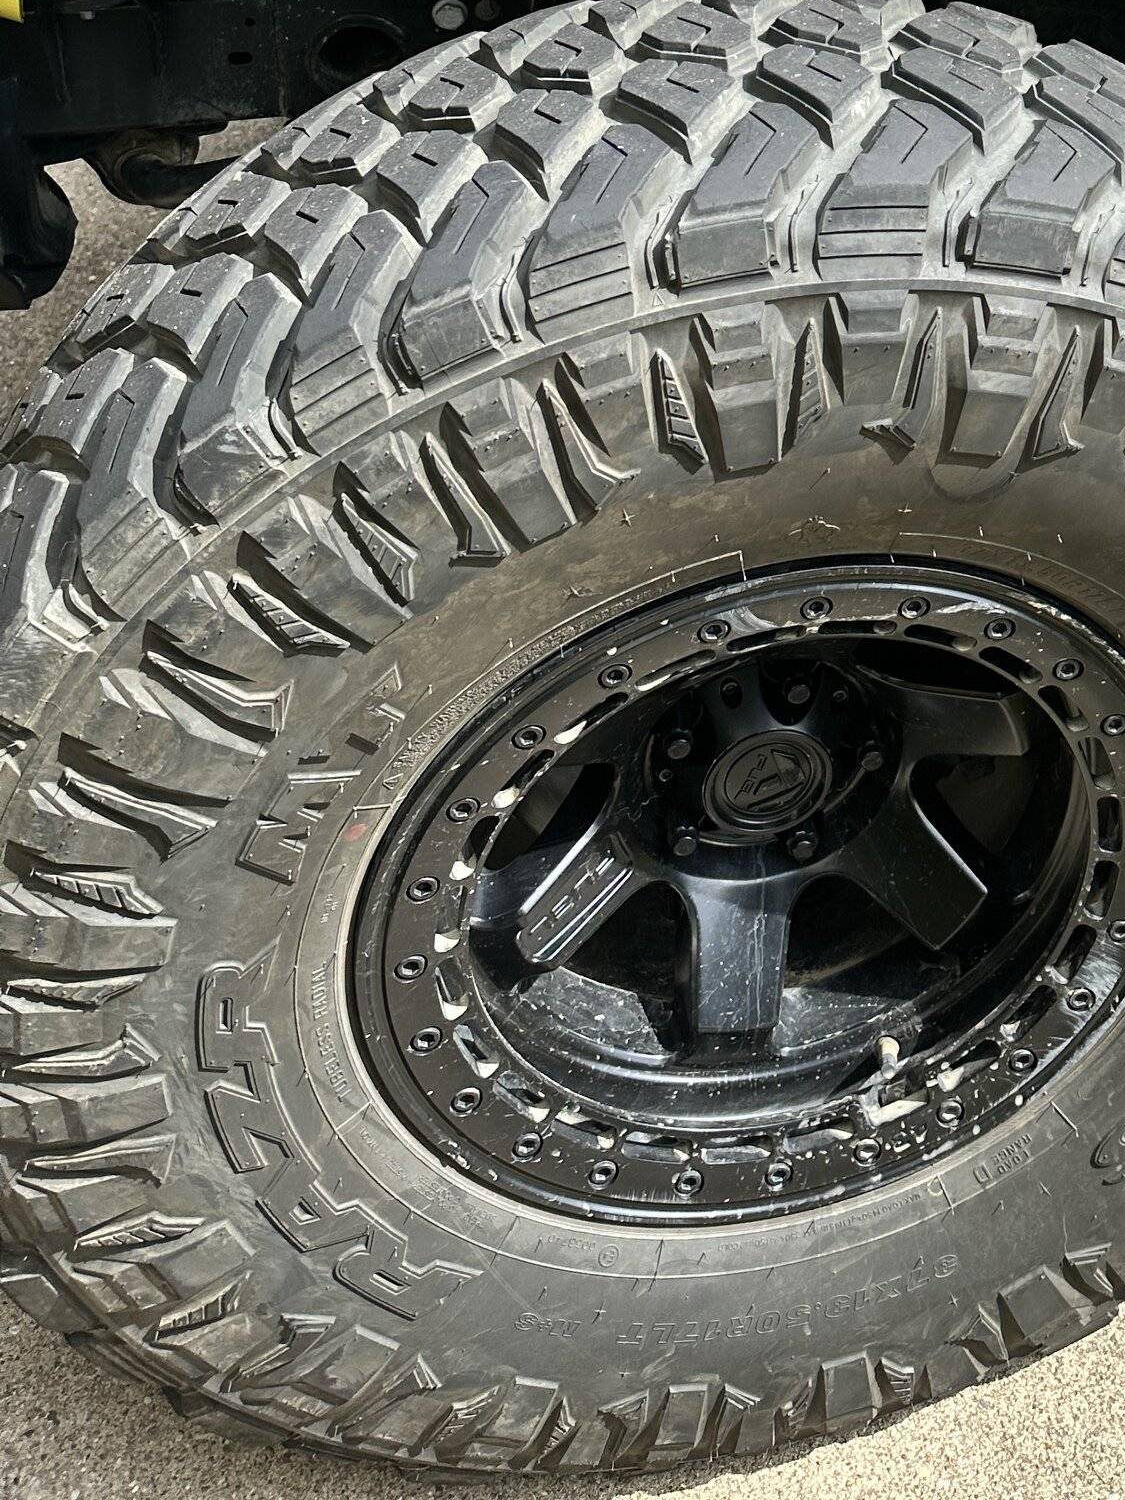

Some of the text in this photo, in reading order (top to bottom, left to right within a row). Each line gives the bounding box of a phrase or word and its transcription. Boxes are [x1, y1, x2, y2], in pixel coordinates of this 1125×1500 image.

[196, 933, 484, 1321] RAZR
[311, 961, 352, 1102] TUBELESS RADIAL
